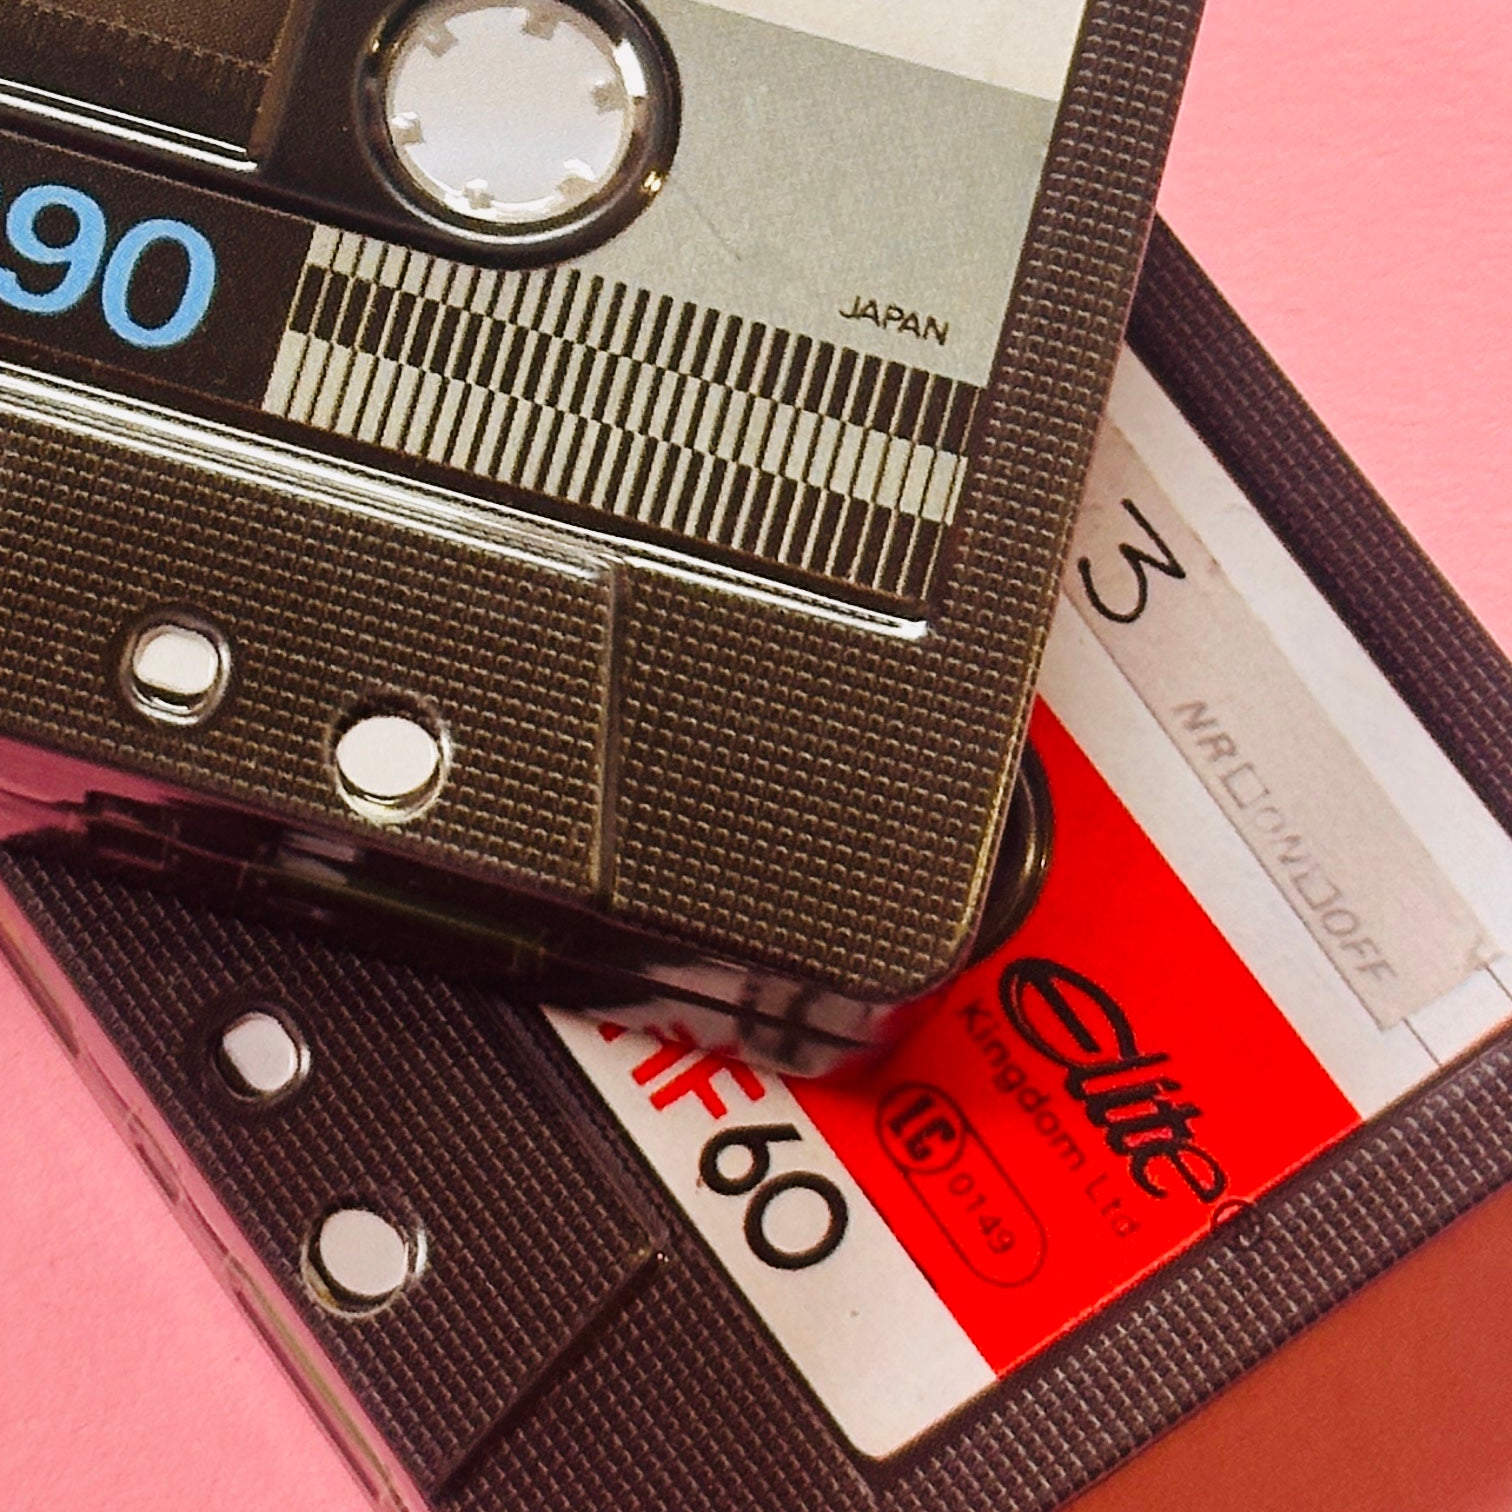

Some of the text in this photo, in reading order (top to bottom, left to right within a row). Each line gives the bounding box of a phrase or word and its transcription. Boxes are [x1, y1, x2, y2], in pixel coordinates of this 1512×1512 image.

[839, 295, 949, 346] JAPAN
[1077, 498, 1187, 624] 3
[1172, 700, 1239, 762] NR
[1321, 908, 1399, 983] OFF
[948, 1171, 1017, 1254] 0149
